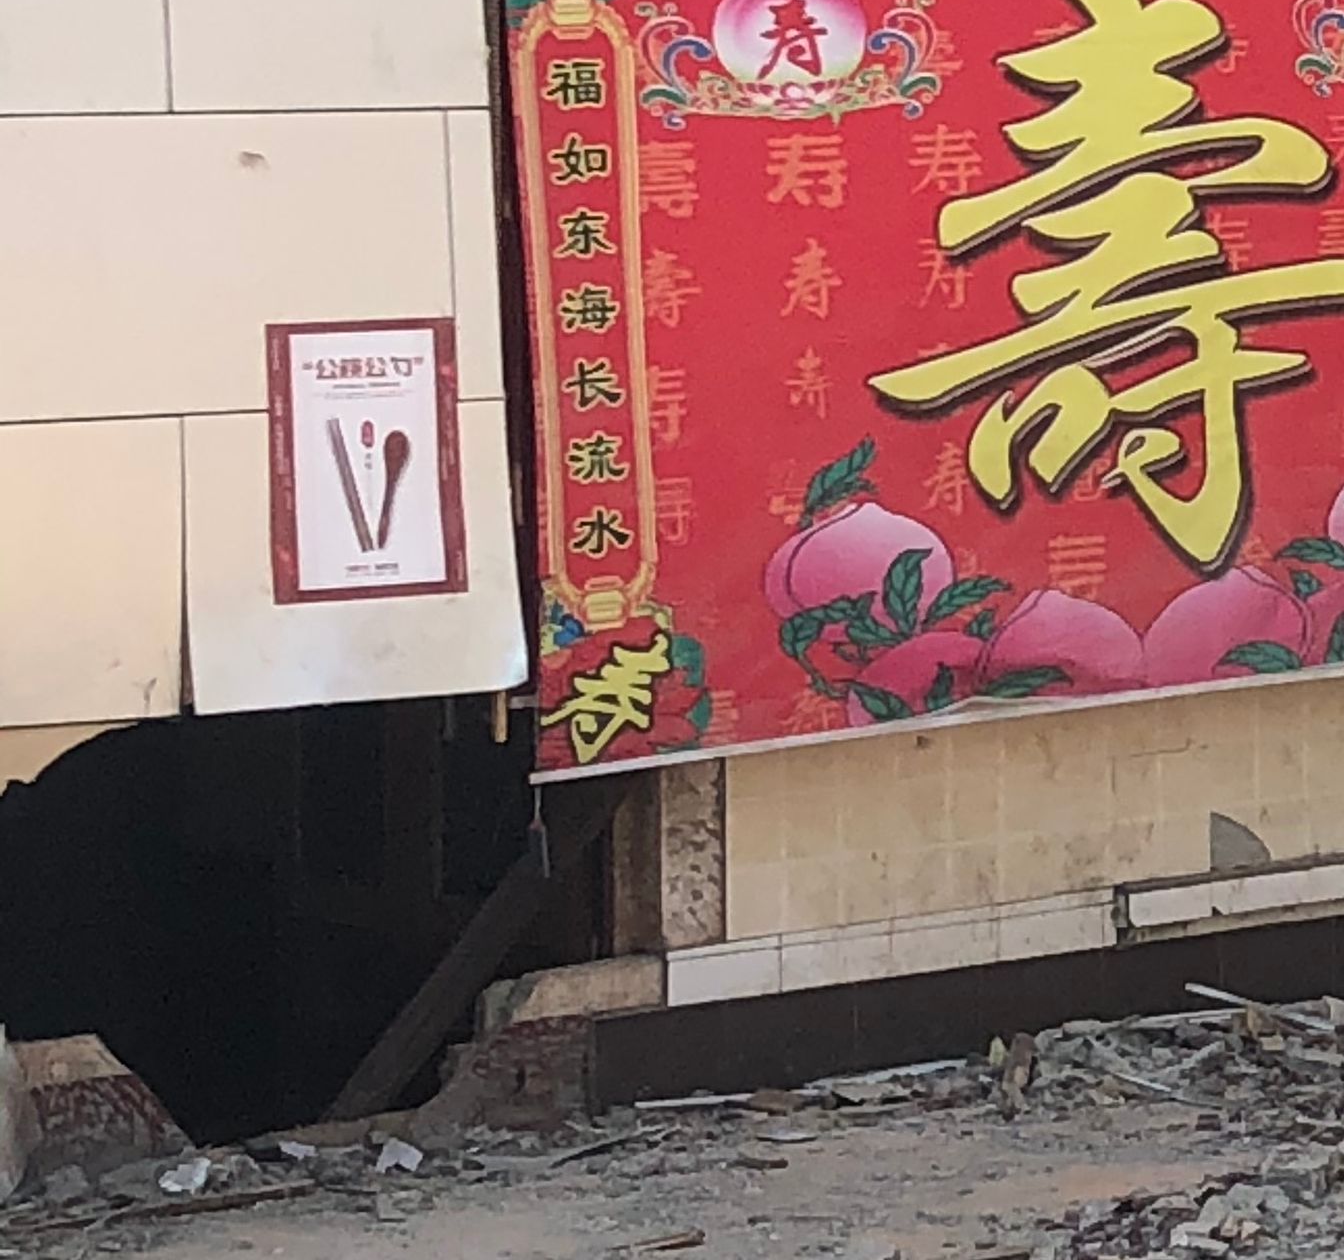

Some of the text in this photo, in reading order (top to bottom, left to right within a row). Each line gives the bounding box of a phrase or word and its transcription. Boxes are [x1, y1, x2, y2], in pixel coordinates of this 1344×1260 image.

[547, 60, 634, 556] 福如东海长流水
